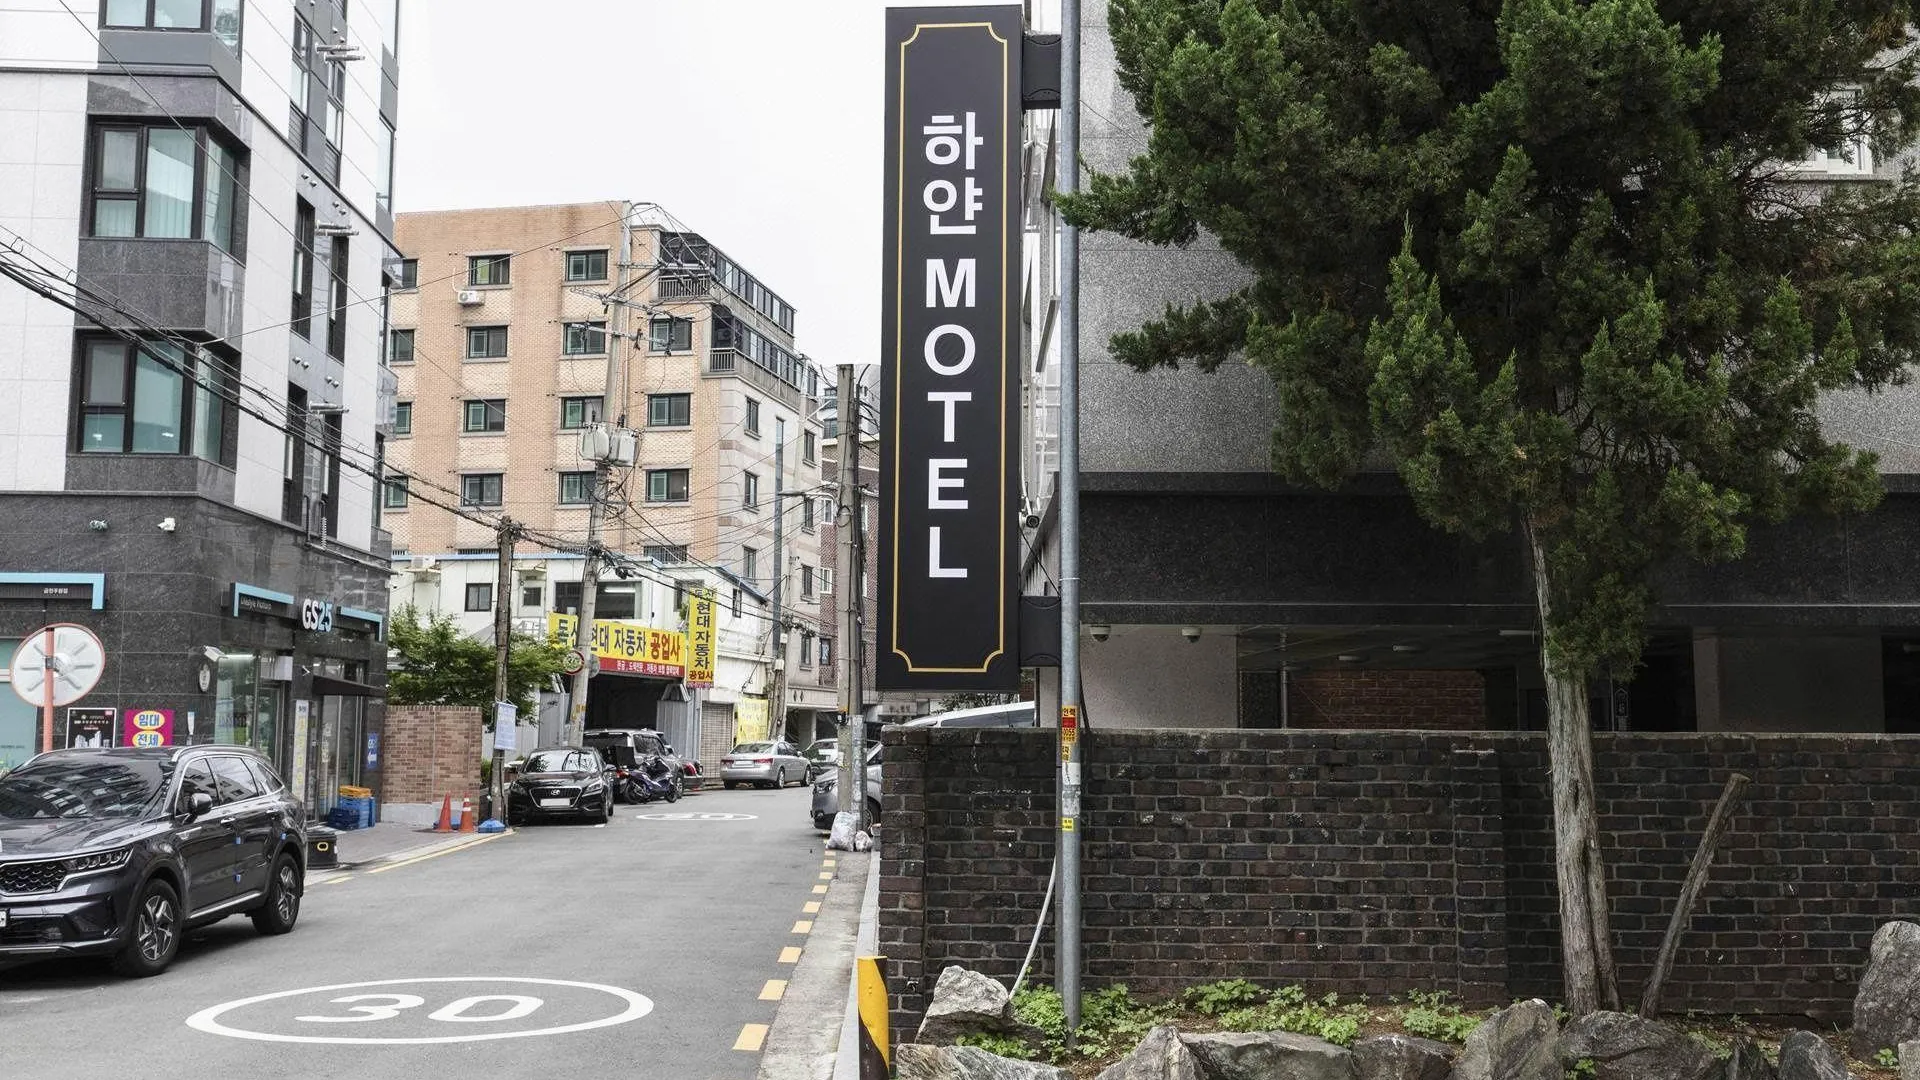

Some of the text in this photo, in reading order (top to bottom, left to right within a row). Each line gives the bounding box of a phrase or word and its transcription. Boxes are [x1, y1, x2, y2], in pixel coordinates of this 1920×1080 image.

[923, 111, 984, 235] 하얀
[924, 258, 976, 578] MOTEL
[302, 598, 333, 632] GS25
[696, 601, 711, 628] 현대
[614, 627, 646, 657] 자동차
[650, 632, 681, 662] 공업사
[694, 630, 711, 670] 자동차
[689, 670, 713, 681] 공업사
[138, 714, 160, 727] 임대
[137, 733, 159, 747] 전세
[294, 993, 545, 1022] 30
